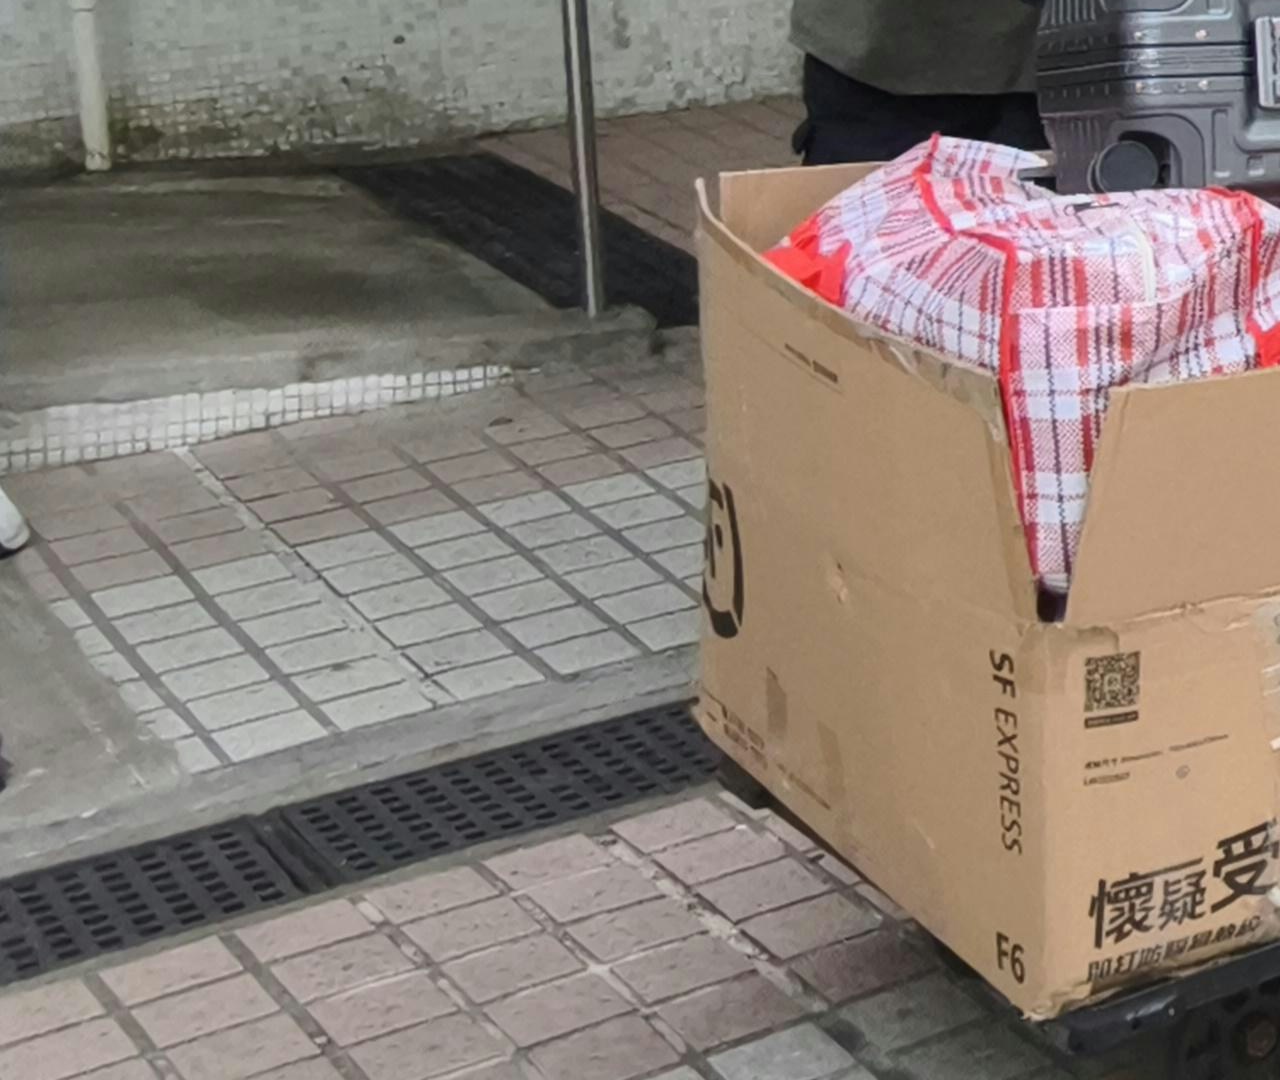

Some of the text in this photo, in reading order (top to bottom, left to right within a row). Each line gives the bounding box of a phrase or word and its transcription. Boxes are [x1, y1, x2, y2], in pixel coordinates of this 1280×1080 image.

[989, 649, 1022, 855] SF EXPRESS
[995, 931, 1025, 984] F6
